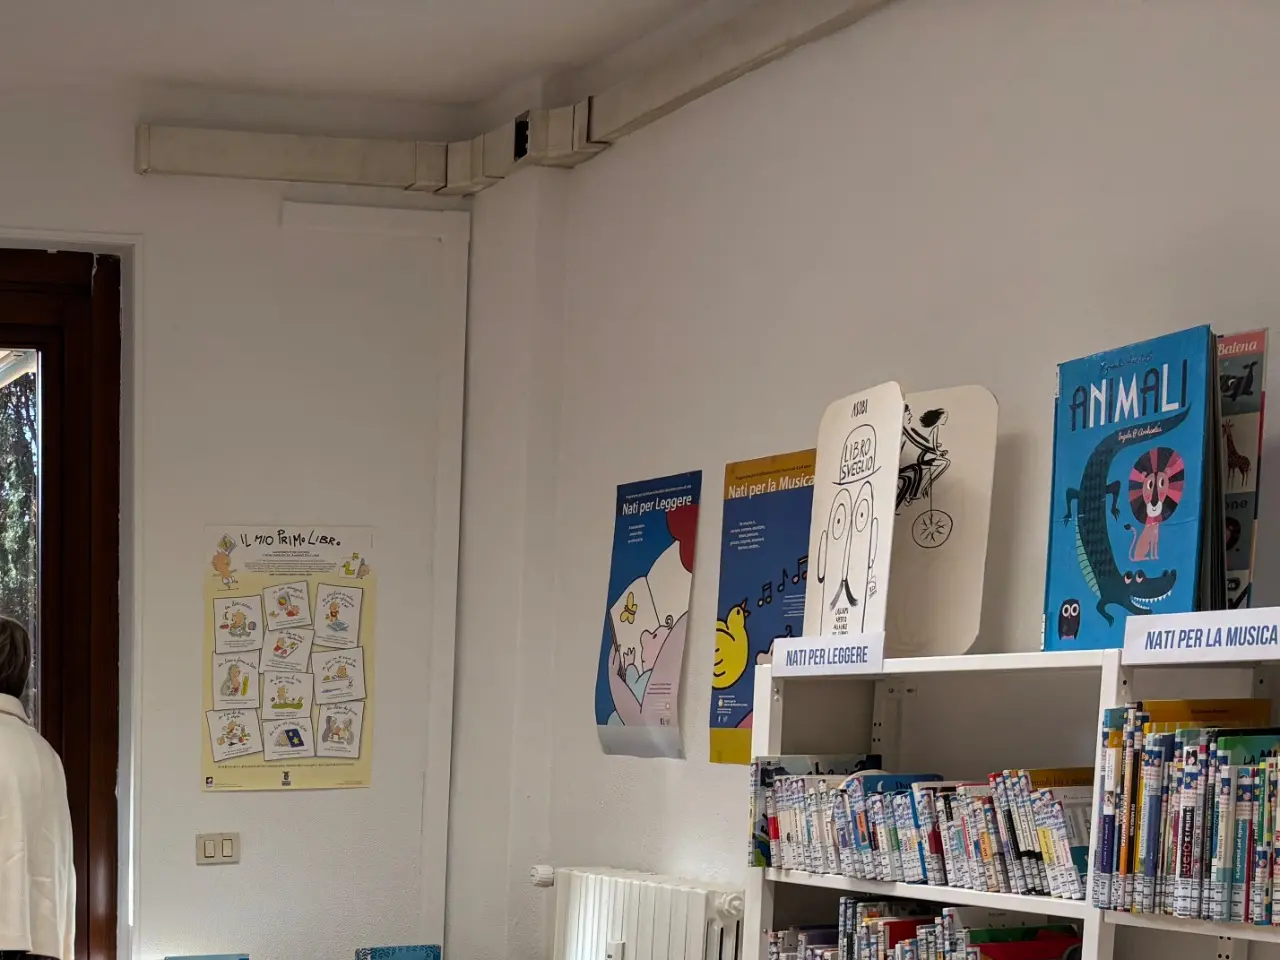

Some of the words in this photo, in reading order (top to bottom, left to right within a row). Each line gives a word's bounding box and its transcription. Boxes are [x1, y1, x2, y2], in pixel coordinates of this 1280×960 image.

[1217, 341, 1257, 356] Balena
[1069, 359, 1188, 431] ANIMALI
[844, 438, 871, 462] LIBRO
[841, 456, 873, 480] SVEGLIO
[728, 482, 748, 499] Nati
[749, 484, 766, 499] per
[767, 478, 776, 492] la
[778, 473, 815, 490] Musica
[622, 501, 638, 516] Nati
[639, 501, 654, 516] per
[655, 495, 692, 512] Leggere
[240, 533, 251, 548] IL
[255, 535, 274, 546] MIO
[1145, 630, 1173, 649] NATI
[1178, 628, 1202, 648] PER
[1206, 627, 1222, 646] LA
[1226, 624, 1278, 645] MUSICA
[786, 650, 806, 667] NATI
[808, 648, 826, 665] PER
[827, 646, 868, 664] LEGGERE
